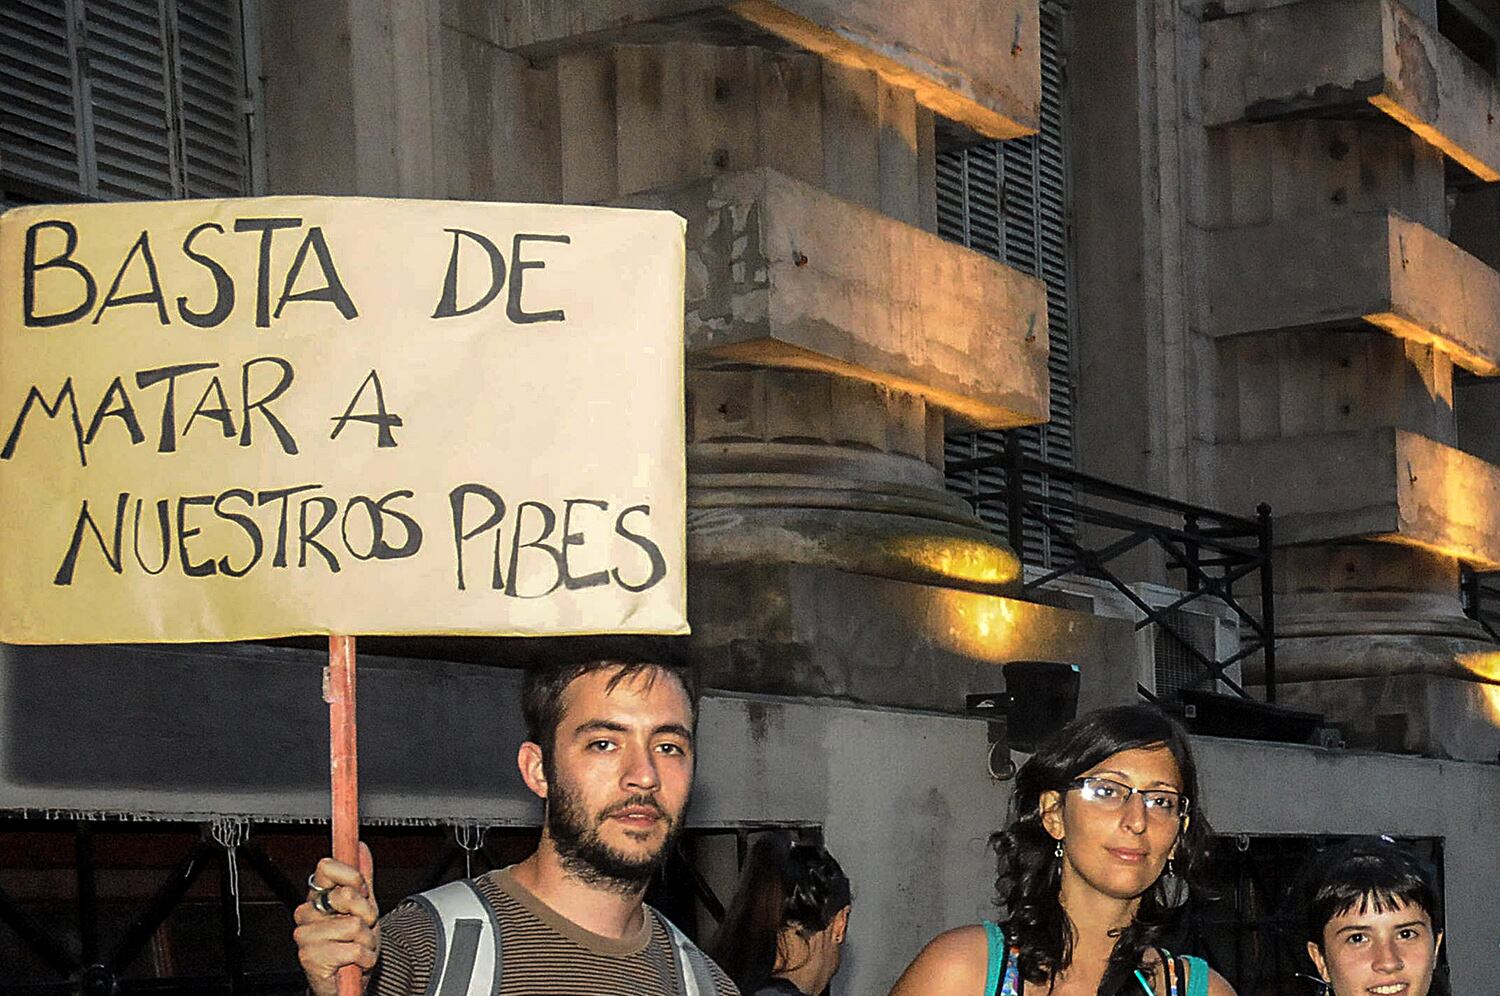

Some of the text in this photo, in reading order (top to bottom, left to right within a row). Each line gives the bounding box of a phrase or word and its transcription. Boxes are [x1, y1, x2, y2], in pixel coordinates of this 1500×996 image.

[24, 218, 571, 328] BASTA DE
[1, 357, 403, 466] MATAR A
[54, 483, 667, 598] NUESTROS PIBES
